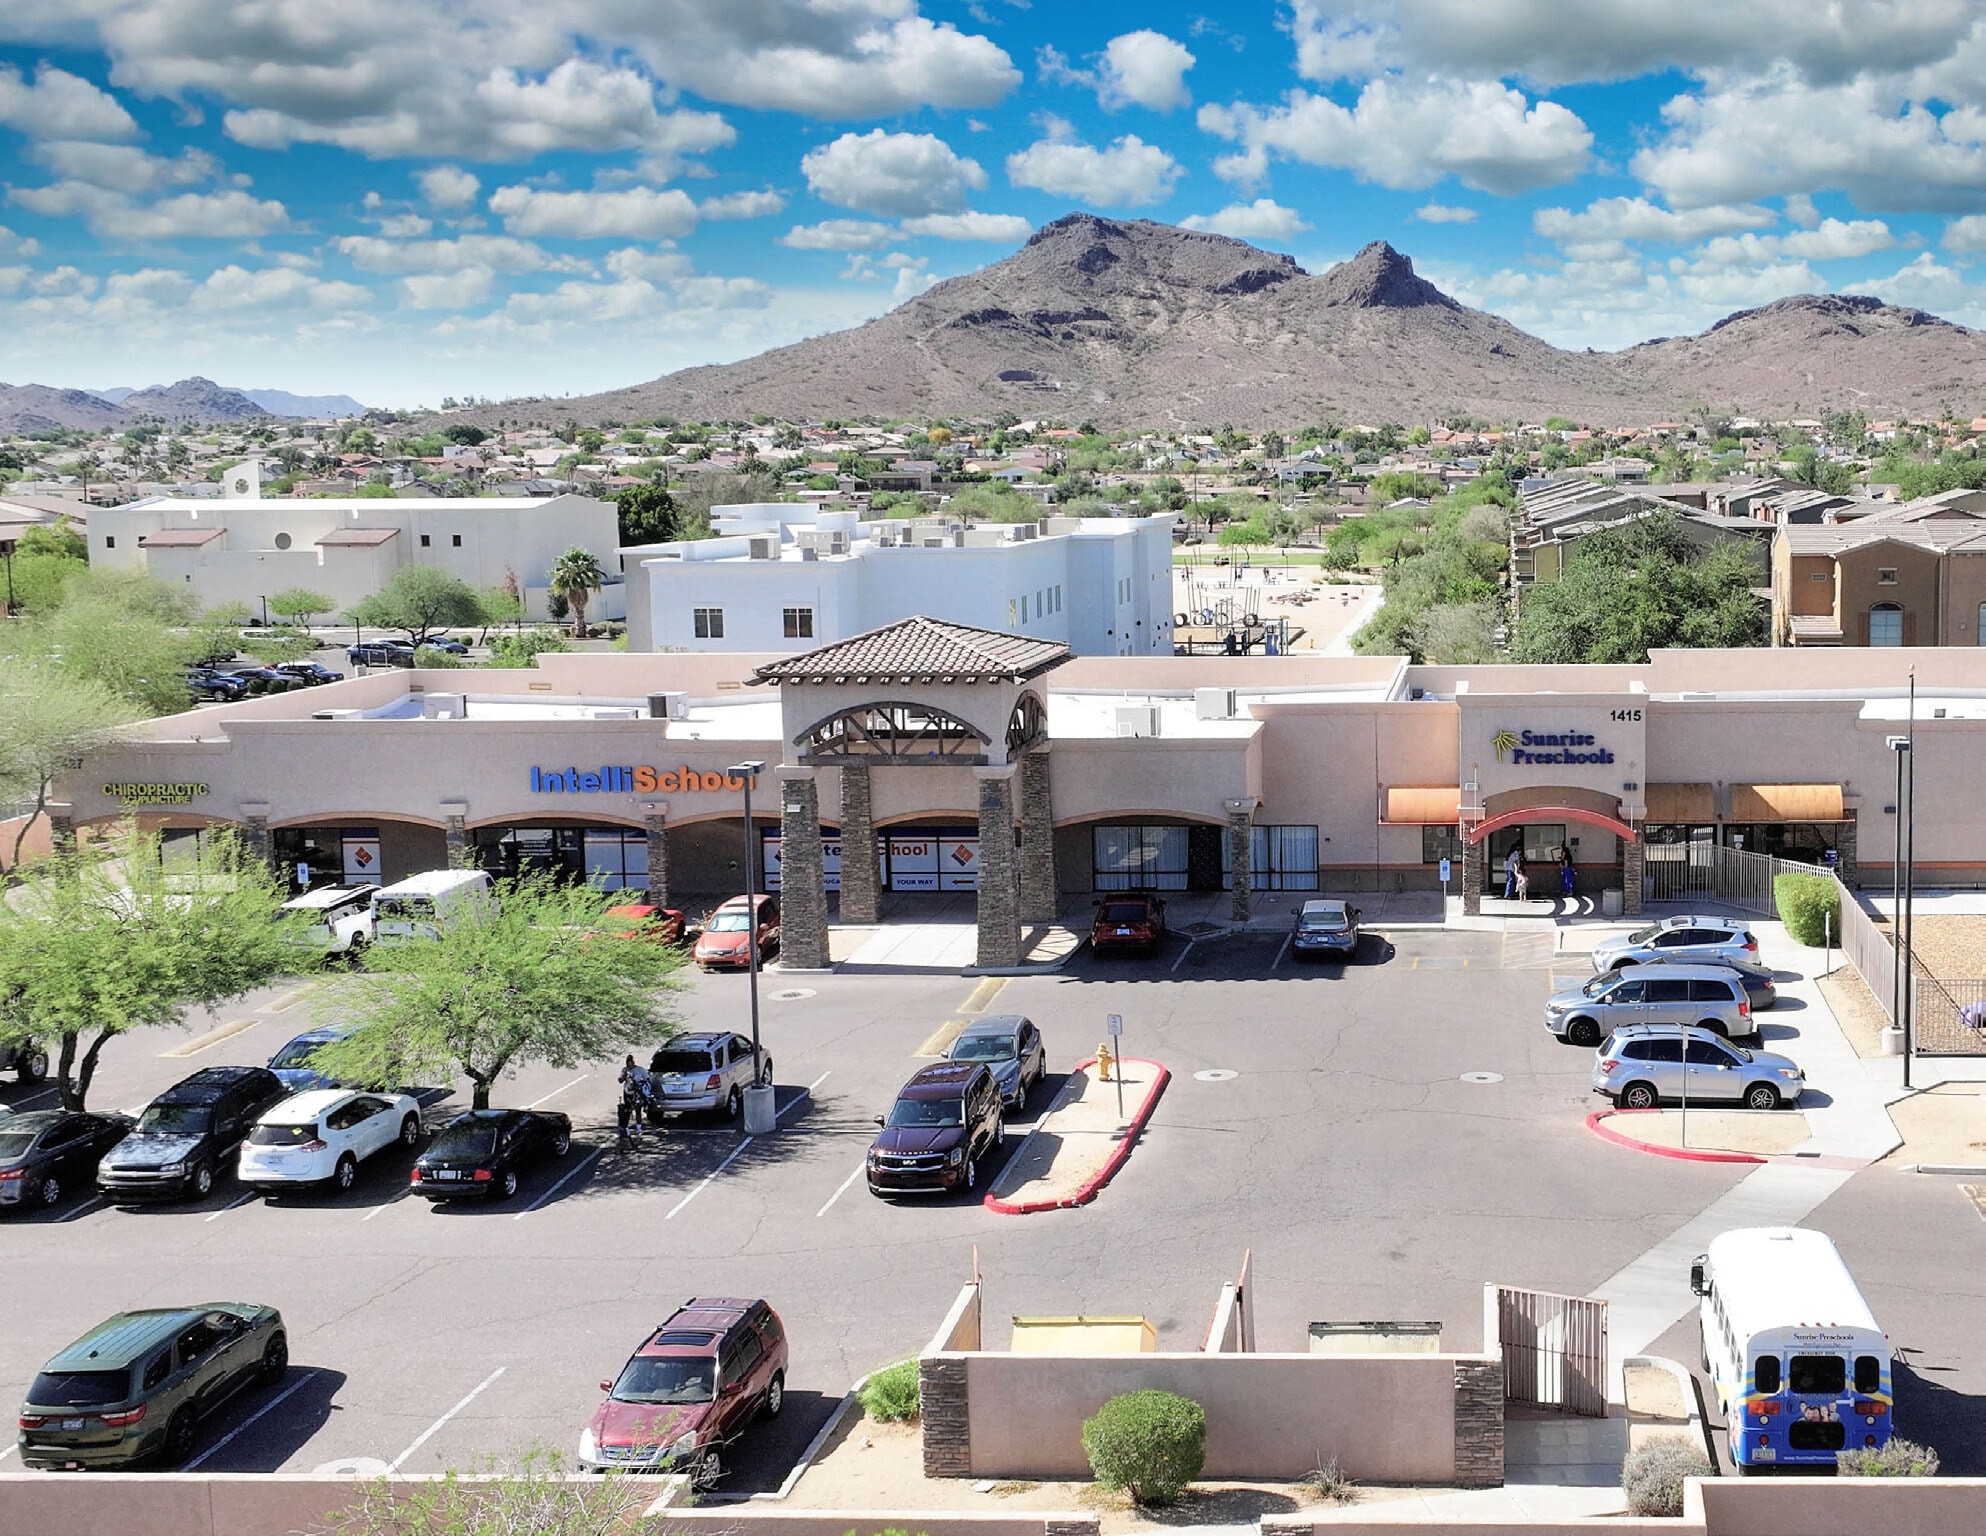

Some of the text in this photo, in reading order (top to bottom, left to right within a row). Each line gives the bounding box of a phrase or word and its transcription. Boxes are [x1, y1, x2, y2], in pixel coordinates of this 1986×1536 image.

[1610, 710, 1642, 722] 1415
[1521, 730, 1595, 747] Sunrise
[1512, 748, 1615, 765] Preschools
[101, 783, 210, 797] CHIROPRACTIC
[121, 795, 193, 805] ACUPUNCTURE
[1793, 1332, 1854, 1341] Sunrise Preschools
